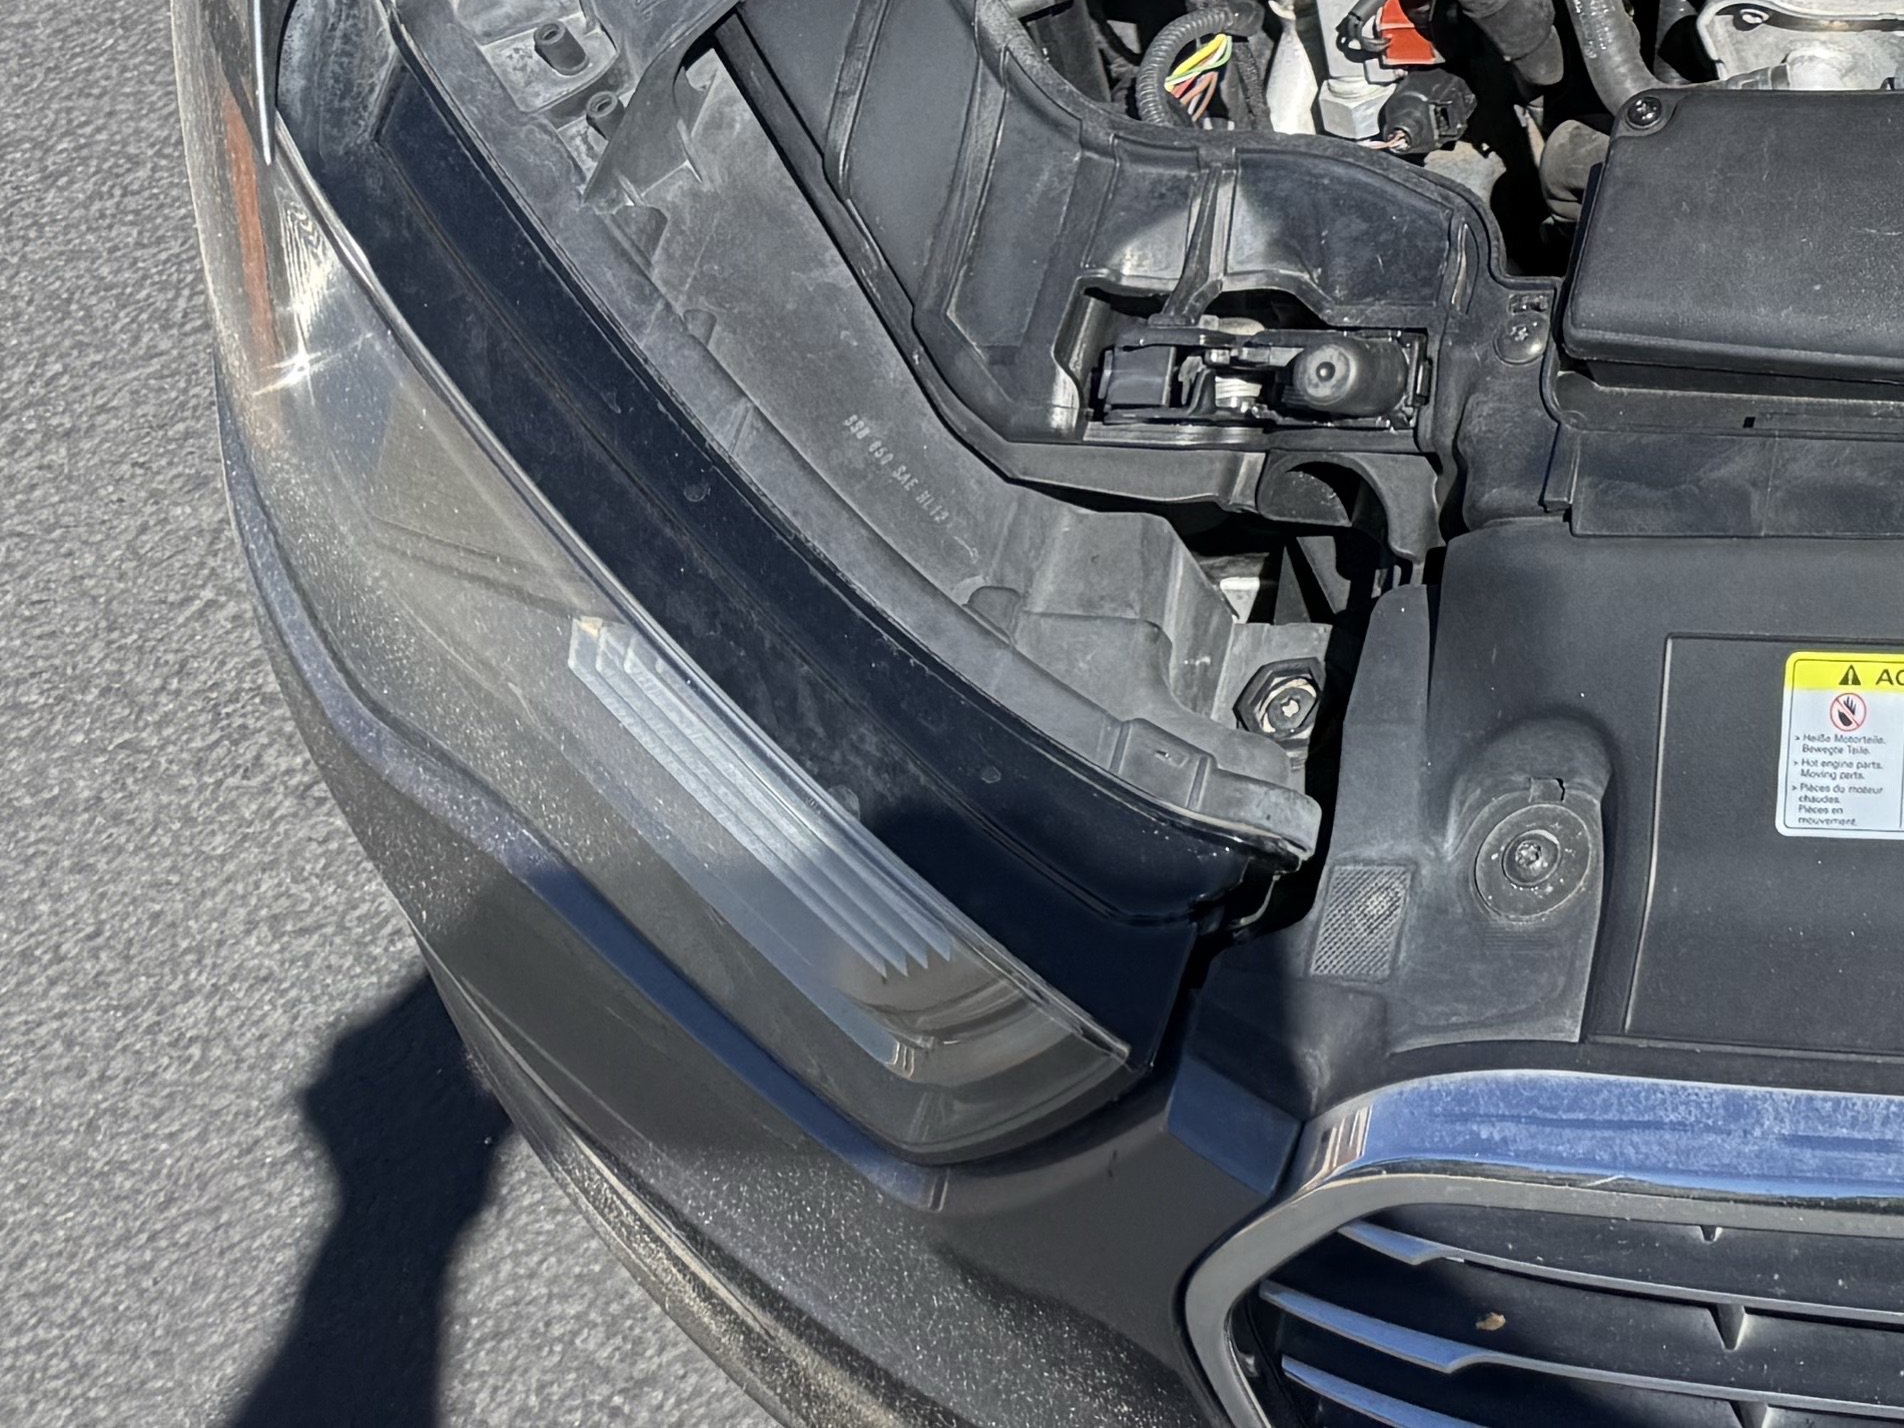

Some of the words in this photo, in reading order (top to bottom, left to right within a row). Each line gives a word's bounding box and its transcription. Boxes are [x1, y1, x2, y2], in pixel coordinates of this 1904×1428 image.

[892, 464, 918, 491] SAE
[1800, 758, 1818, 767] Hot
[1820, 760, 1854, 769] engine
[1800, 768, 1837, 780] Moving
[1848, 786, 1884, 794] moteur
[1831, 806, 1844, 814] en
